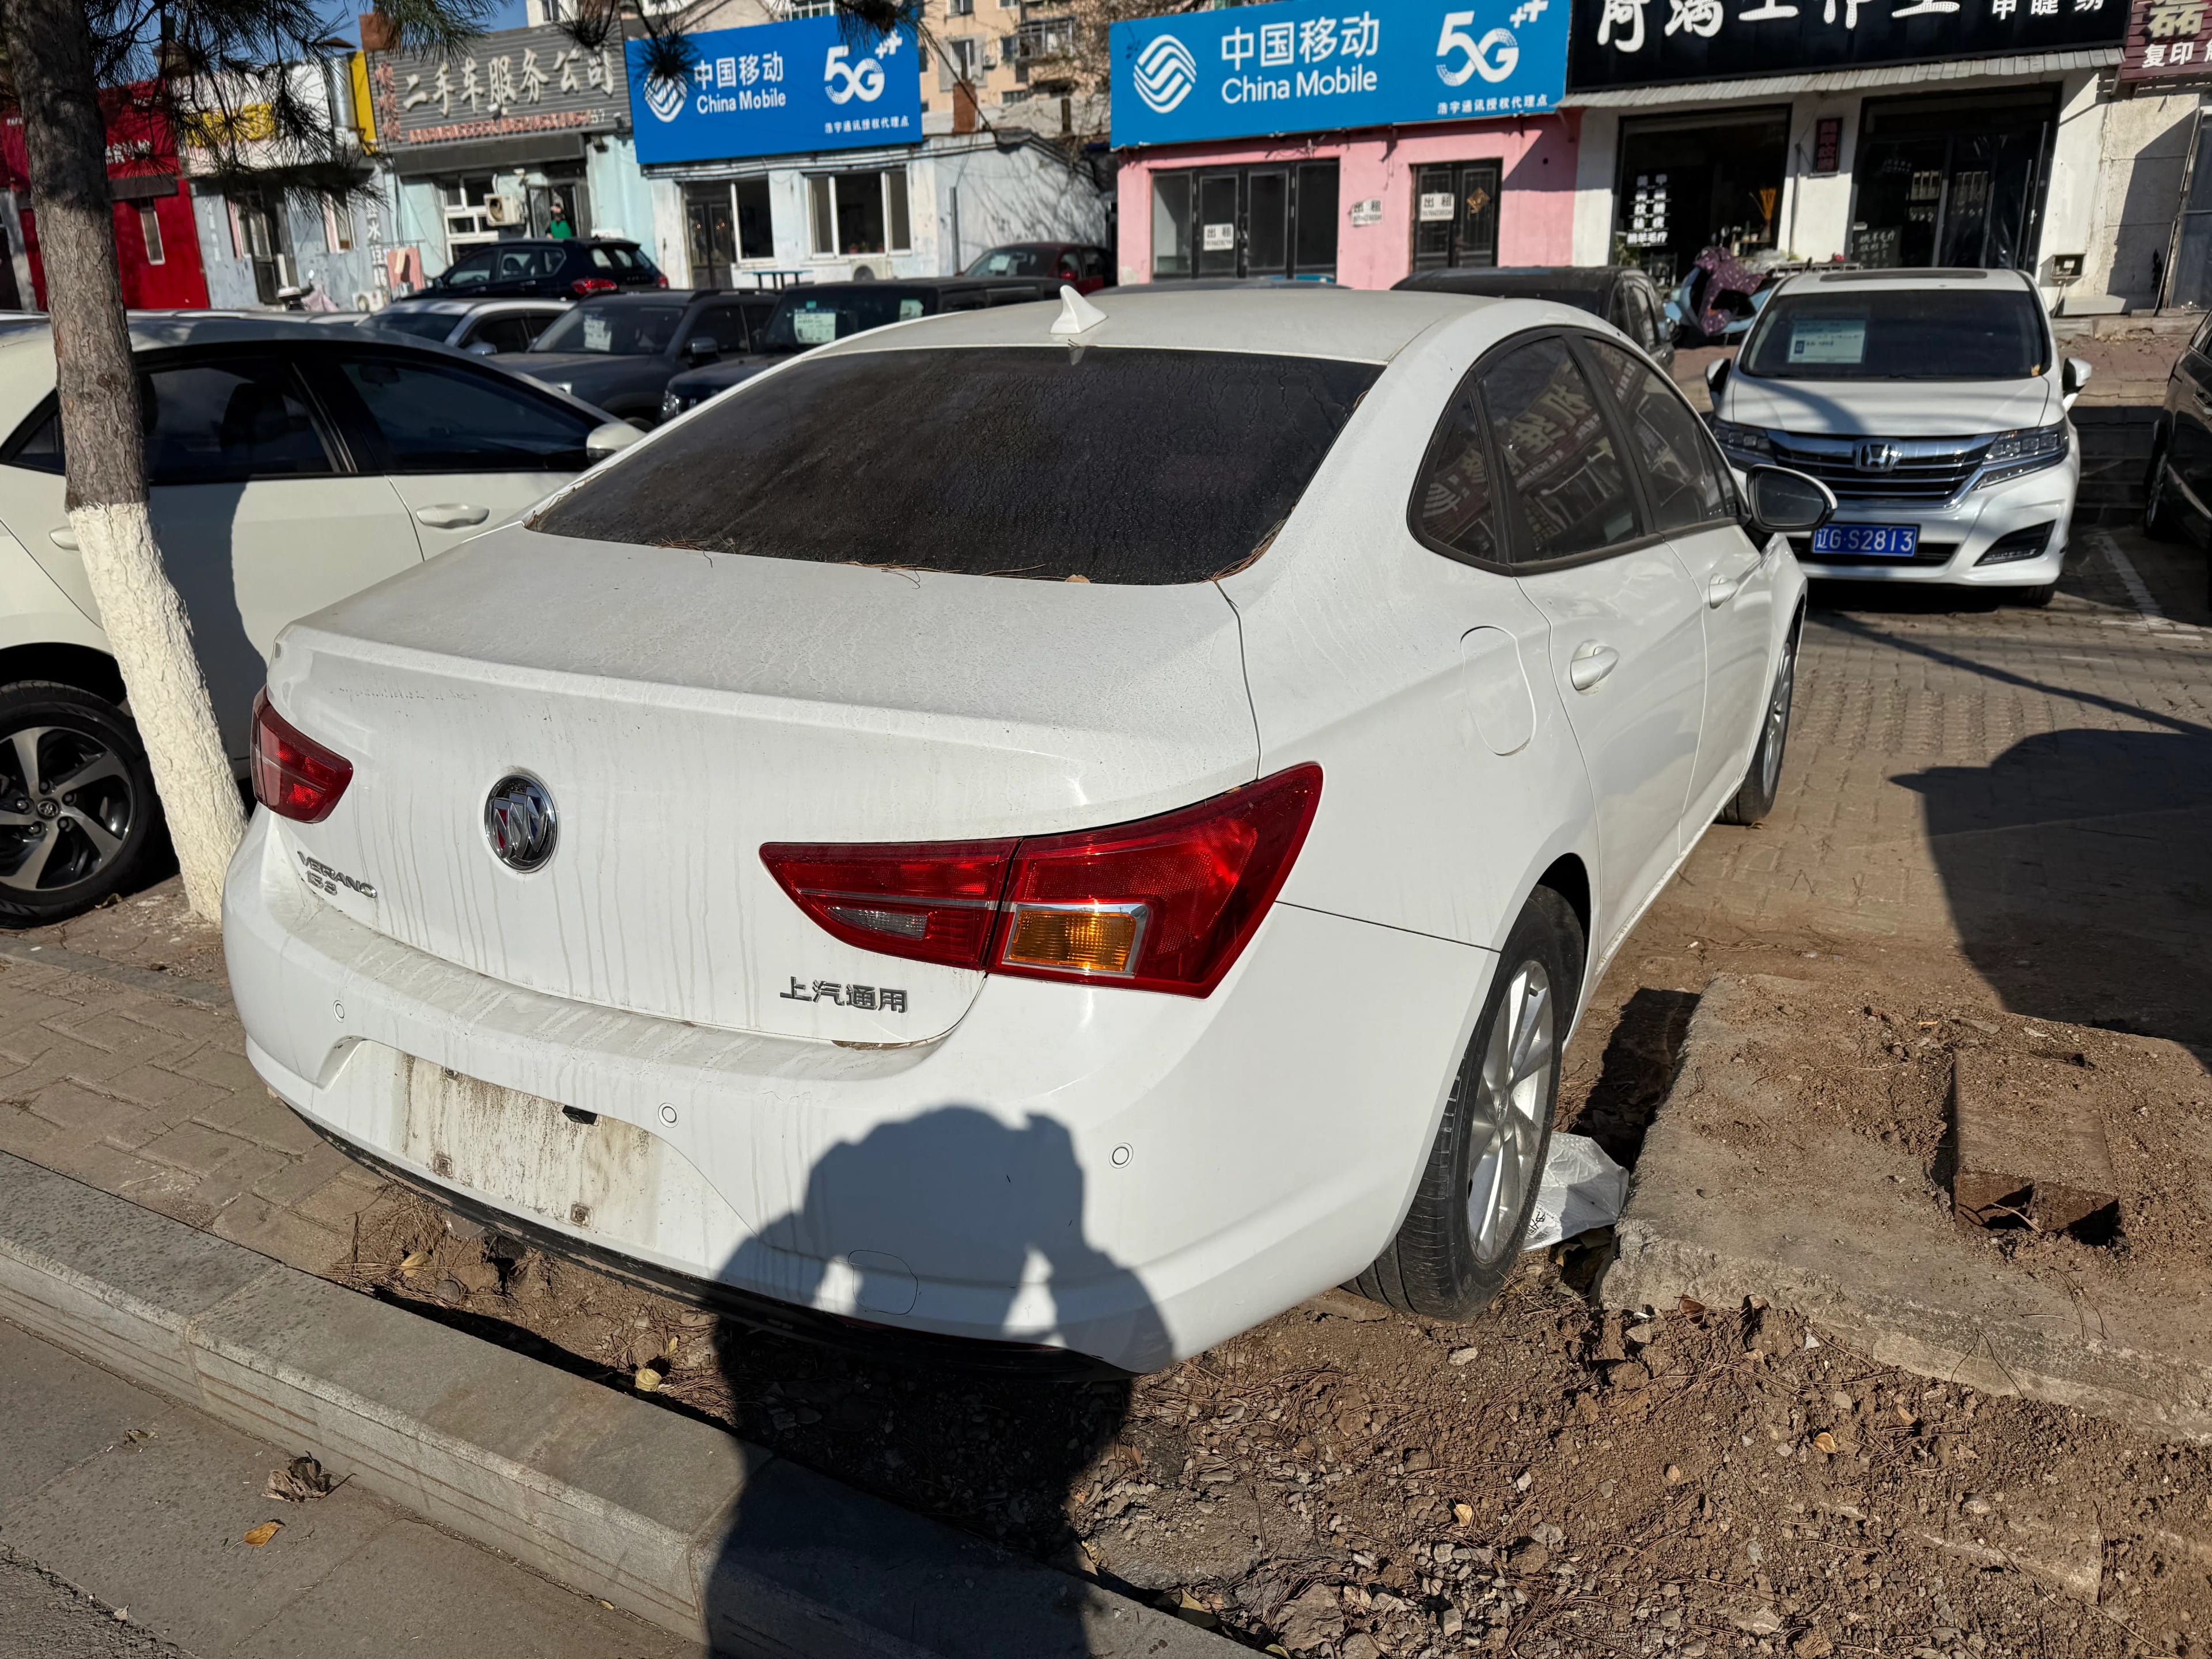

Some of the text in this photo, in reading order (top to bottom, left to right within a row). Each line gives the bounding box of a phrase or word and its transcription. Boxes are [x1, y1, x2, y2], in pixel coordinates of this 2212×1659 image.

[1221, 11, 1380, 71] 中国移动
[2142, 41, 2194, 68] 复印
[403, 47, 614, 118] 二手车服务公司
[694, 51, 784, 90] 中国移动
[1221, 63, 1377, 104] China Mobile
[696, 88, 786, 114] China Mobile
[297, 850, 377, 898] VERANO
[780, 976, 908, 1013] 上汽通用
